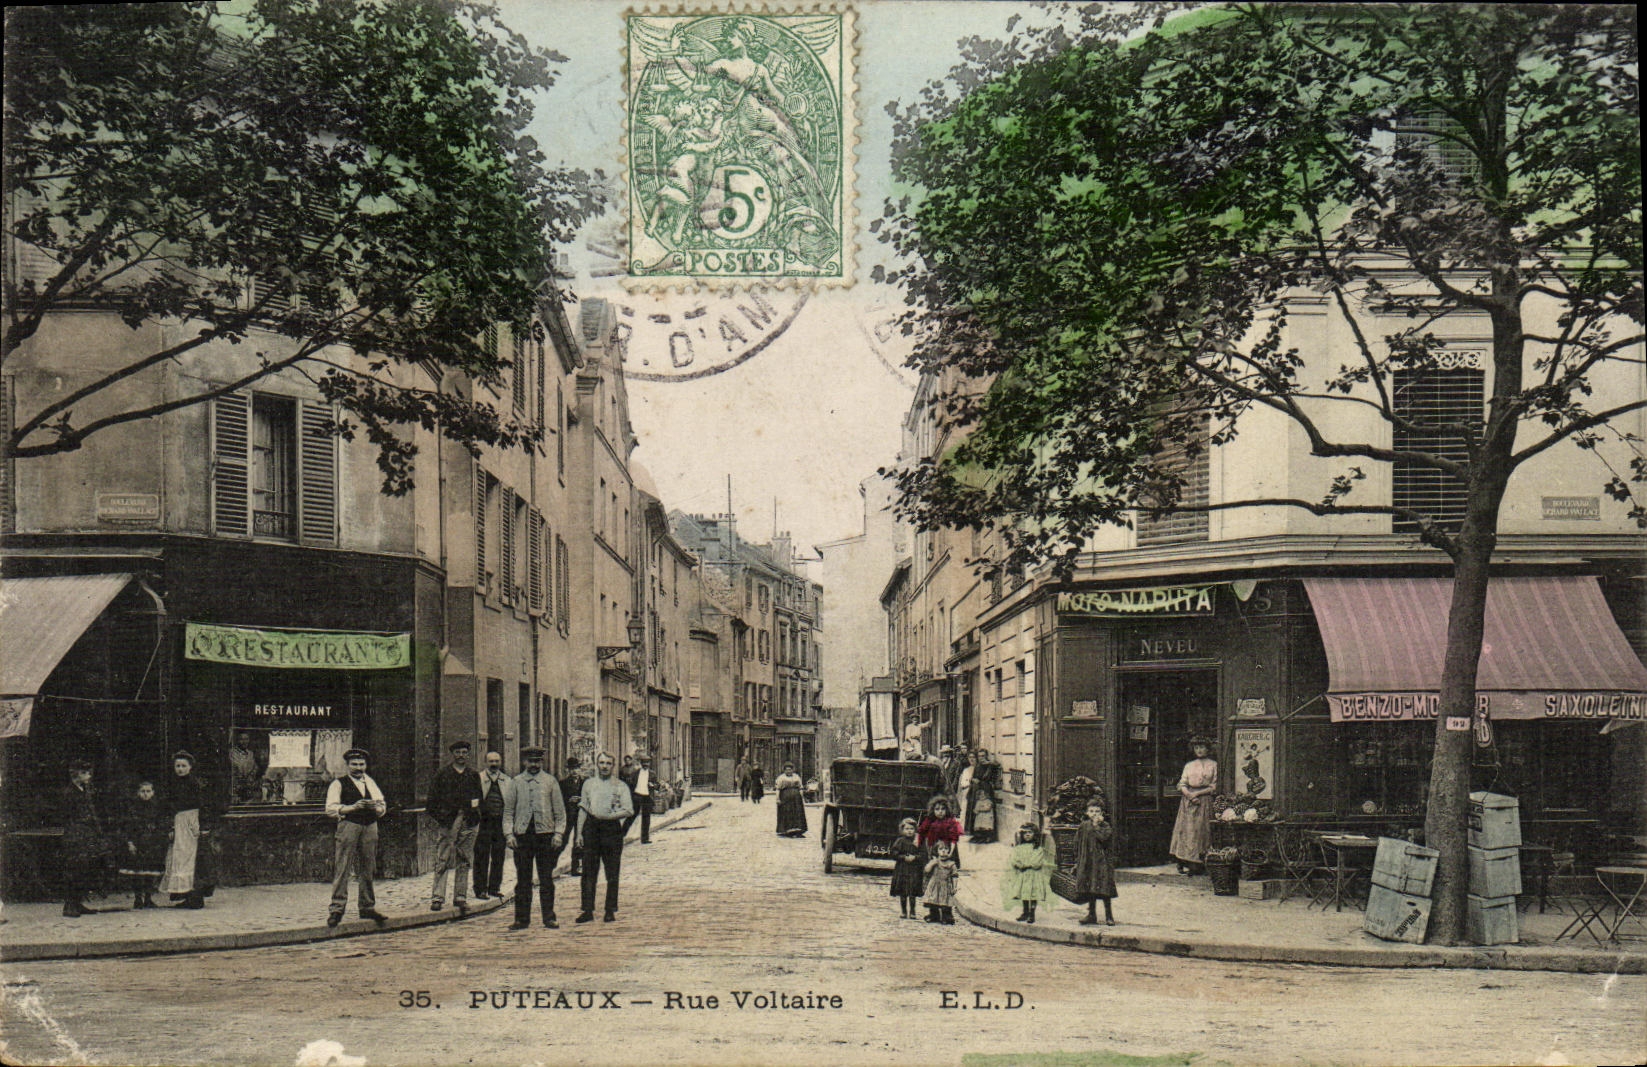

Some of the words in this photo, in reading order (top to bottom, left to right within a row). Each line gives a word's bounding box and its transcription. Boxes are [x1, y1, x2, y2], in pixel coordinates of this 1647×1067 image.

[692, 252, 780, 273] POSTES
[216, 632, 385, 665] RESTAURANT
[1140, 639, 1198, 655] NEVEU
[254, 703, 332, 717] RESTAURANT
[1544, 695, 1647, 719] SAXOLEIN
